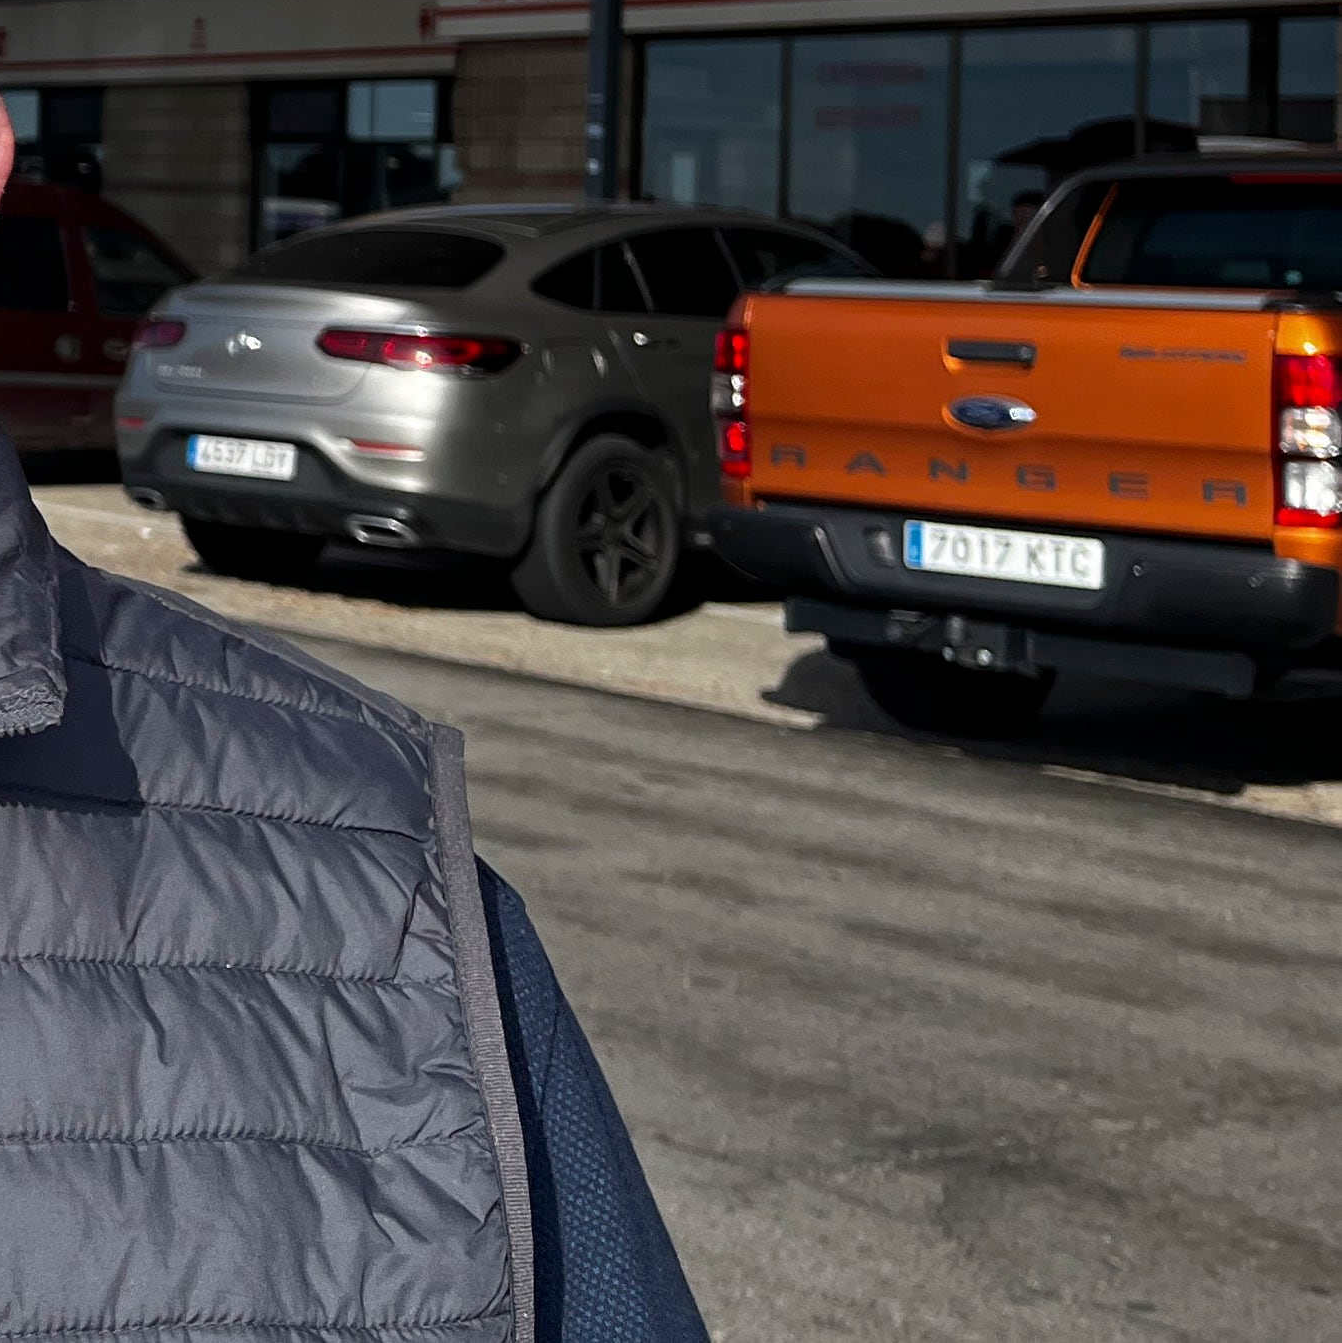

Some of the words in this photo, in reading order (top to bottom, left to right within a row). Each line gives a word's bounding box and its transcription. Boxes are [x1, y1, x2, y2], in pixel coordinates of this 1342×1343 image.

[770, 443, 1249, 508] RANGER
[928, 528, 1013, 568] 7017
[1025, 538, 1092, 580] KTC
